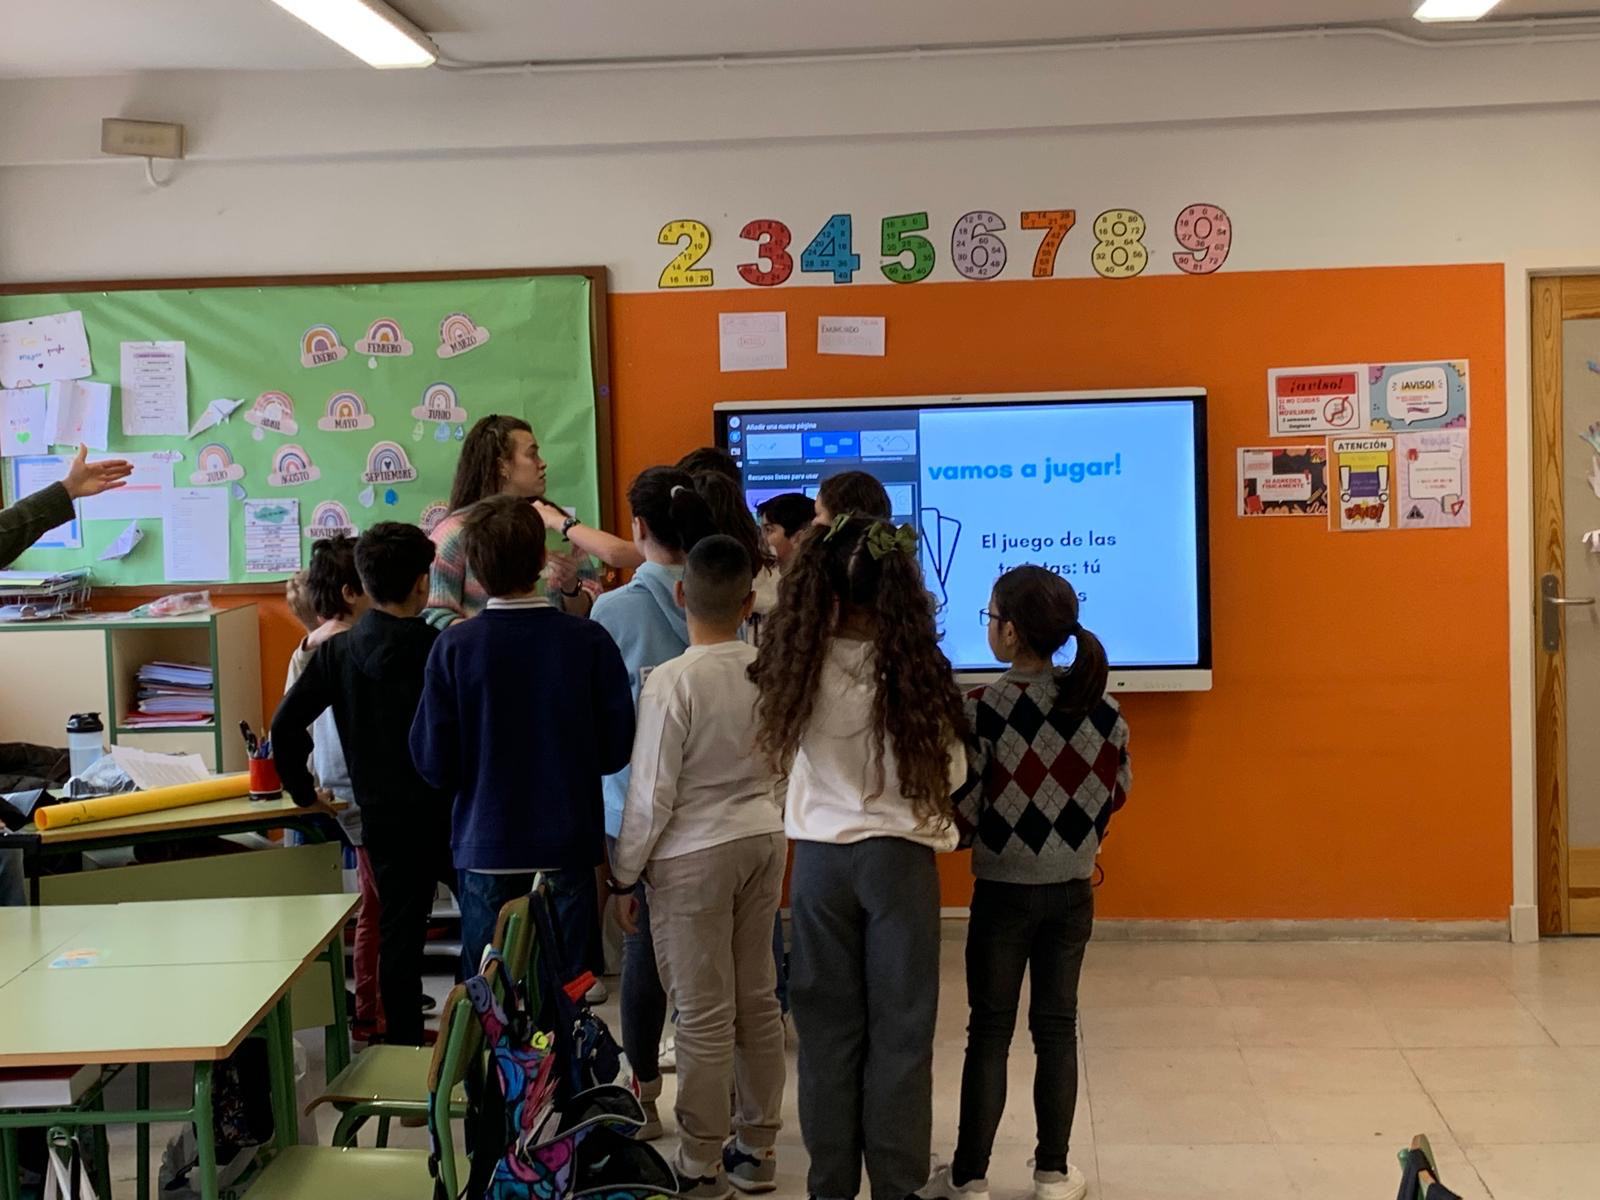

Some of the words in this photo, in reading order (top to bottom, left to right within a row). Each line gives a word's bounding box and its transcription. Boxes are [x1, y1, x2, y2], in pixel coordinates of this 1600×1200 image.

[658, 219, 713, 289] 2
[737, 219, 793, 286] 3
[800, 214, 860, 284] 4
[881, 211, 935, 284] 5
[951, 211, 1007, 280] 6
[1021, 210, 1076, 277] 7
[1091, 208, 1148, 280] 8
[1173, 203, 1232, 275] 9
[367, 342, 402, 354] FEBRERO
[450, 336, 477, 353] MARZO
[312, 351, 338, 365] ENERO
[334, 418, 358, 429] MAYO
[1338, 440, 1387, 450] ATENCIÓN
[365, 469, 412, 482] SEPTIEMBRE
[928, 464, 1013, 480] vamos
[1020, 463, 1037, 478] a
[1043, 453, 1122, 484] jugar!
[207, 470, 228, 482] JULIO
[281, 471, 310, 485] AGOSTO
[982, 533, 996, 549] El
[1001, 533, 1054, 553] juego
[1060, 531, 1083, 547] de
[1089, 530, 1116, 546] las
[1083, 558, 1100, 574] tú
